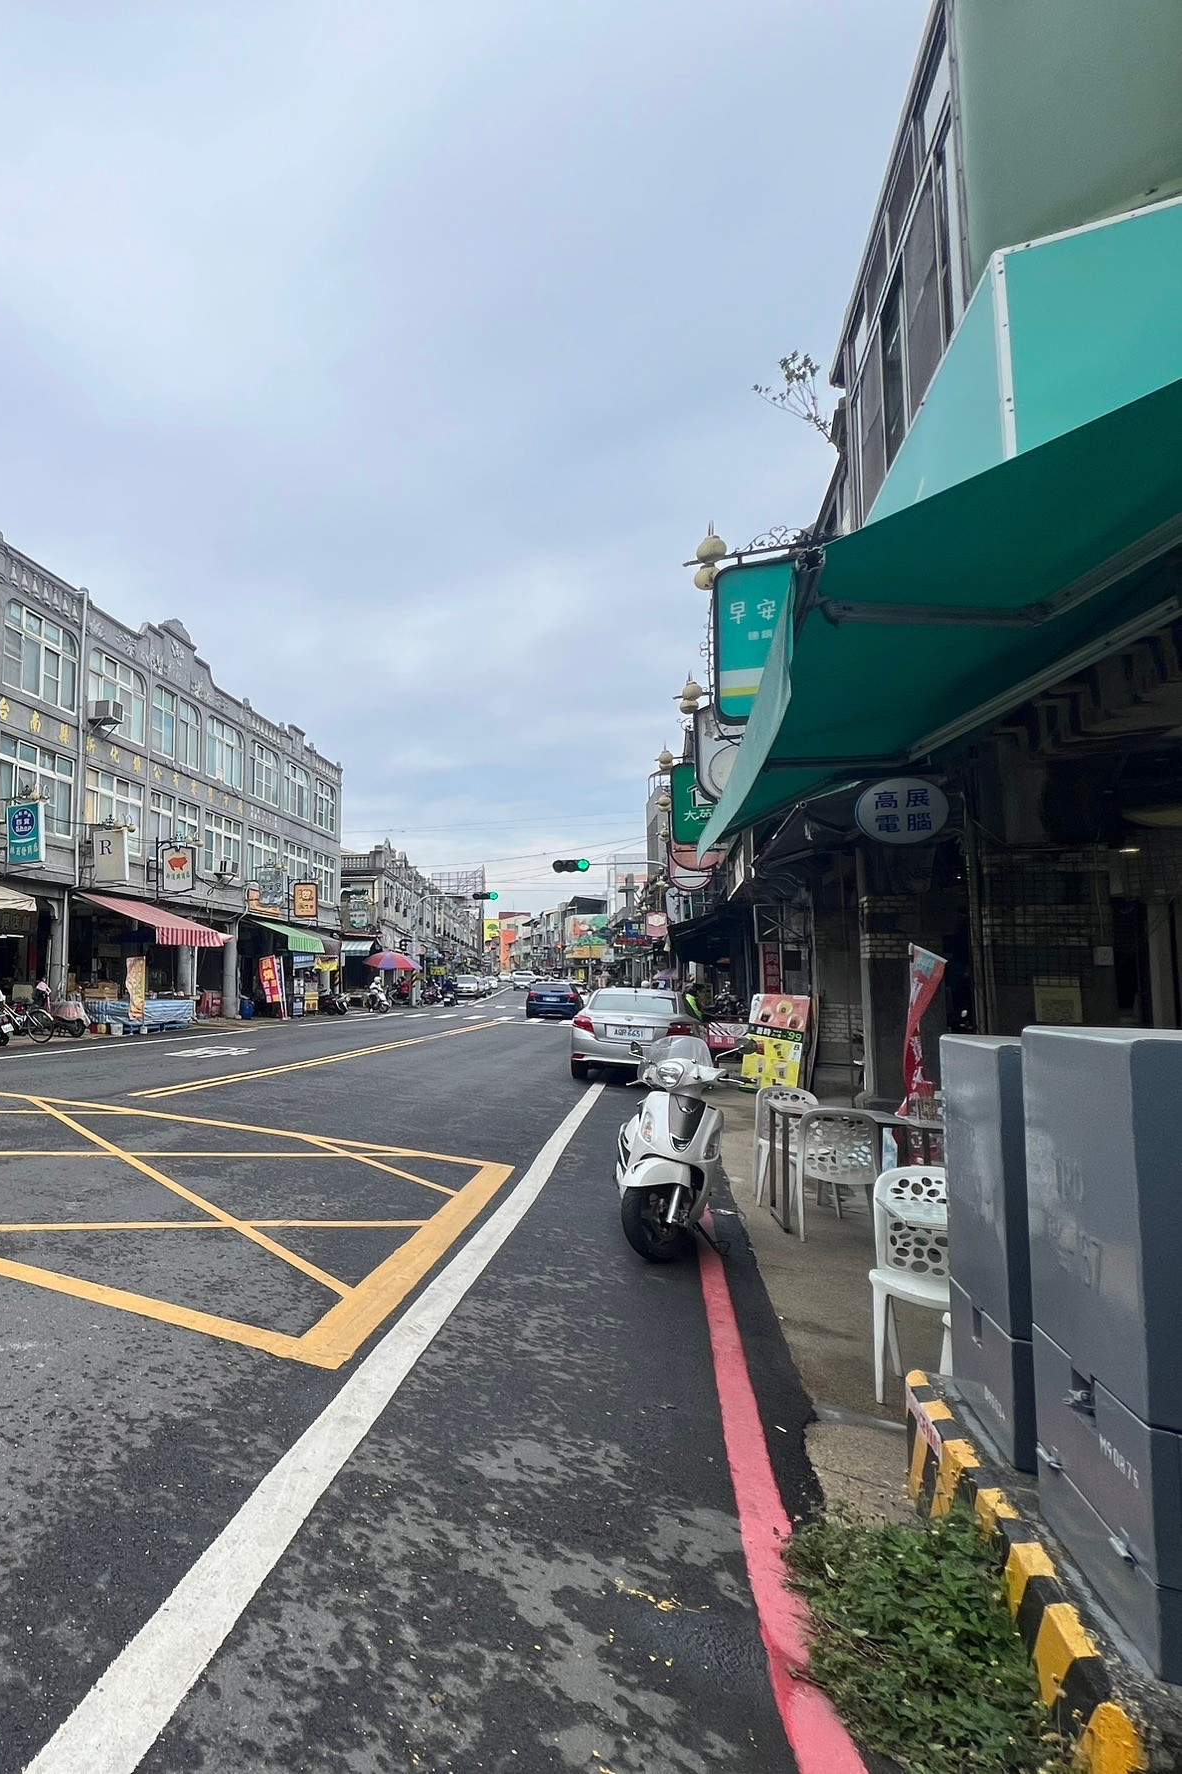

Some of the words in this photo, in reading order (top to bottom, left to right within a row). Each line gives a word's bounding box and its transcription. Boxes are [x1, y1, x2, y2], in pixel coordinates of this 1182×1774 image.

[730, 599, 776, 624] 早安
[874, 788, 930, 810] 高展
[875, 812, 932, 832] 電腦
[99, 839, 113, 856] R
